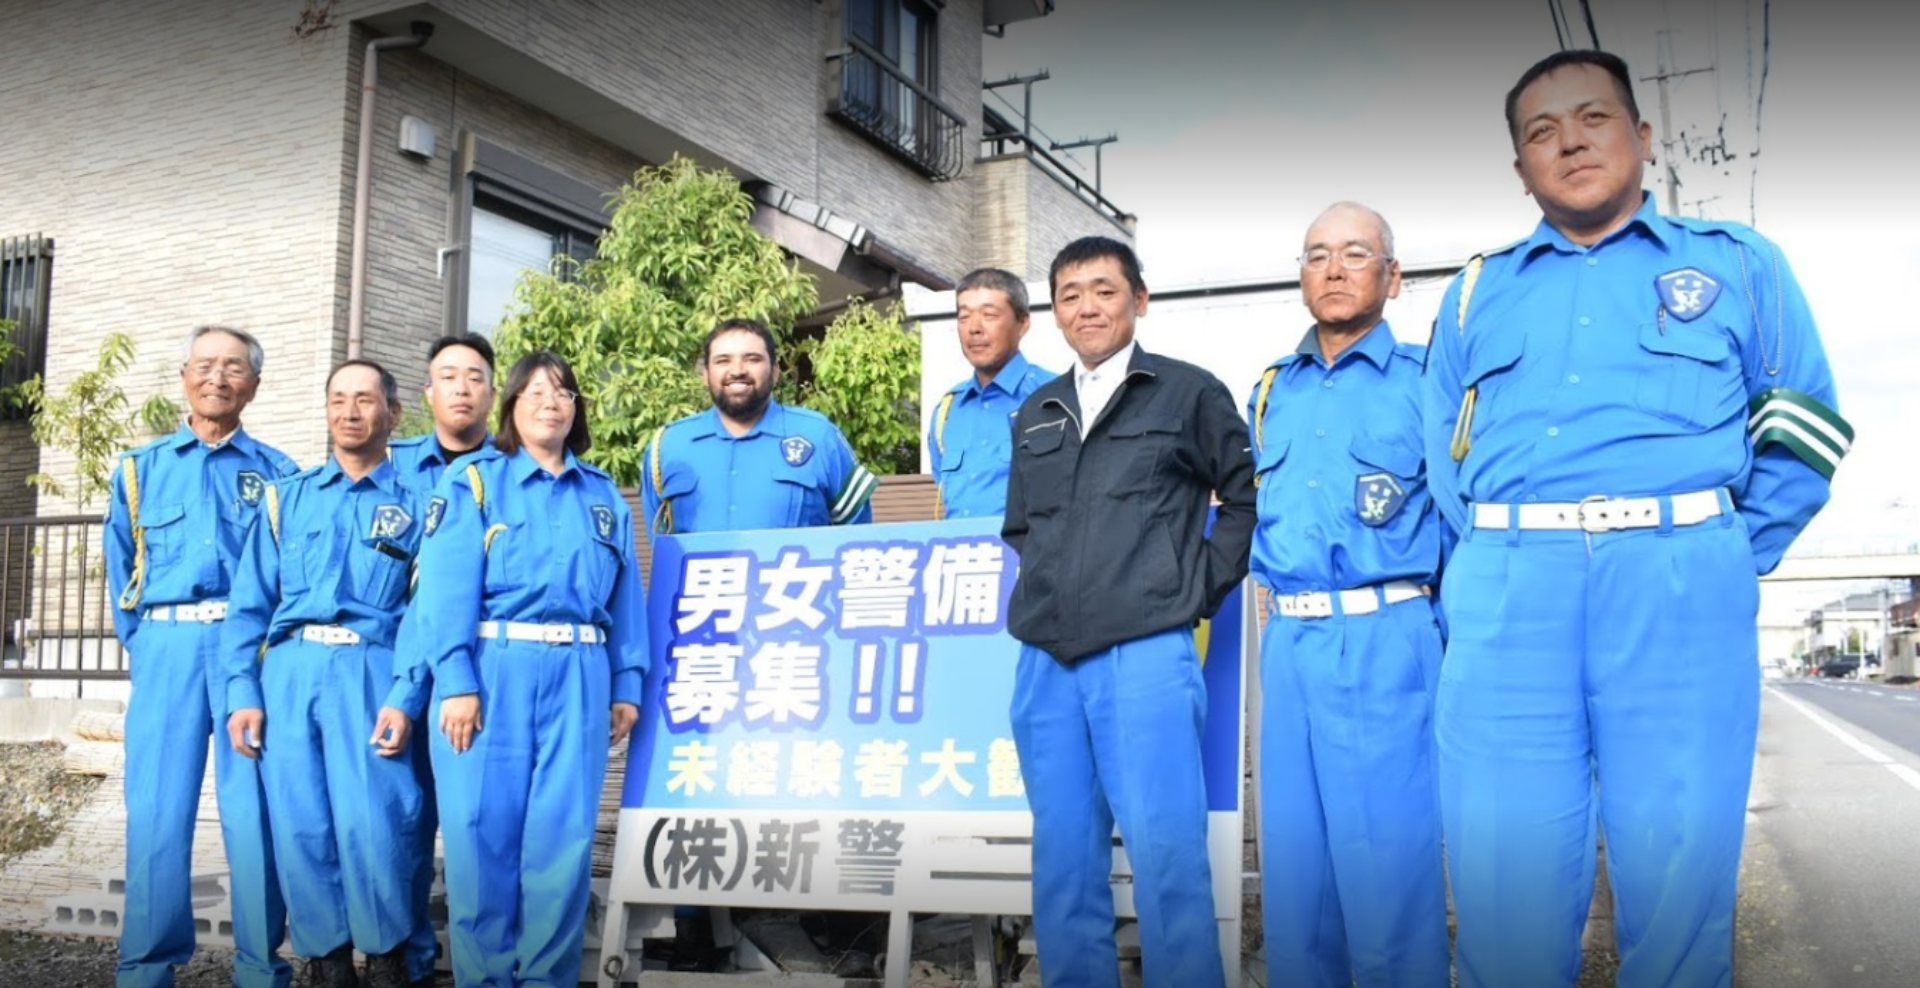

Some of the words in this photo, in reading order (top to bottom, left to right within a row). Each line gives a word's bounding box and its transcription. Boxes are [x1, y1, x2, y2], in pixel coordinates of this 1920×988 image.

[677, 543, 1020, 634] 男女警備
[644, 817, 905, 894] (株)新警
